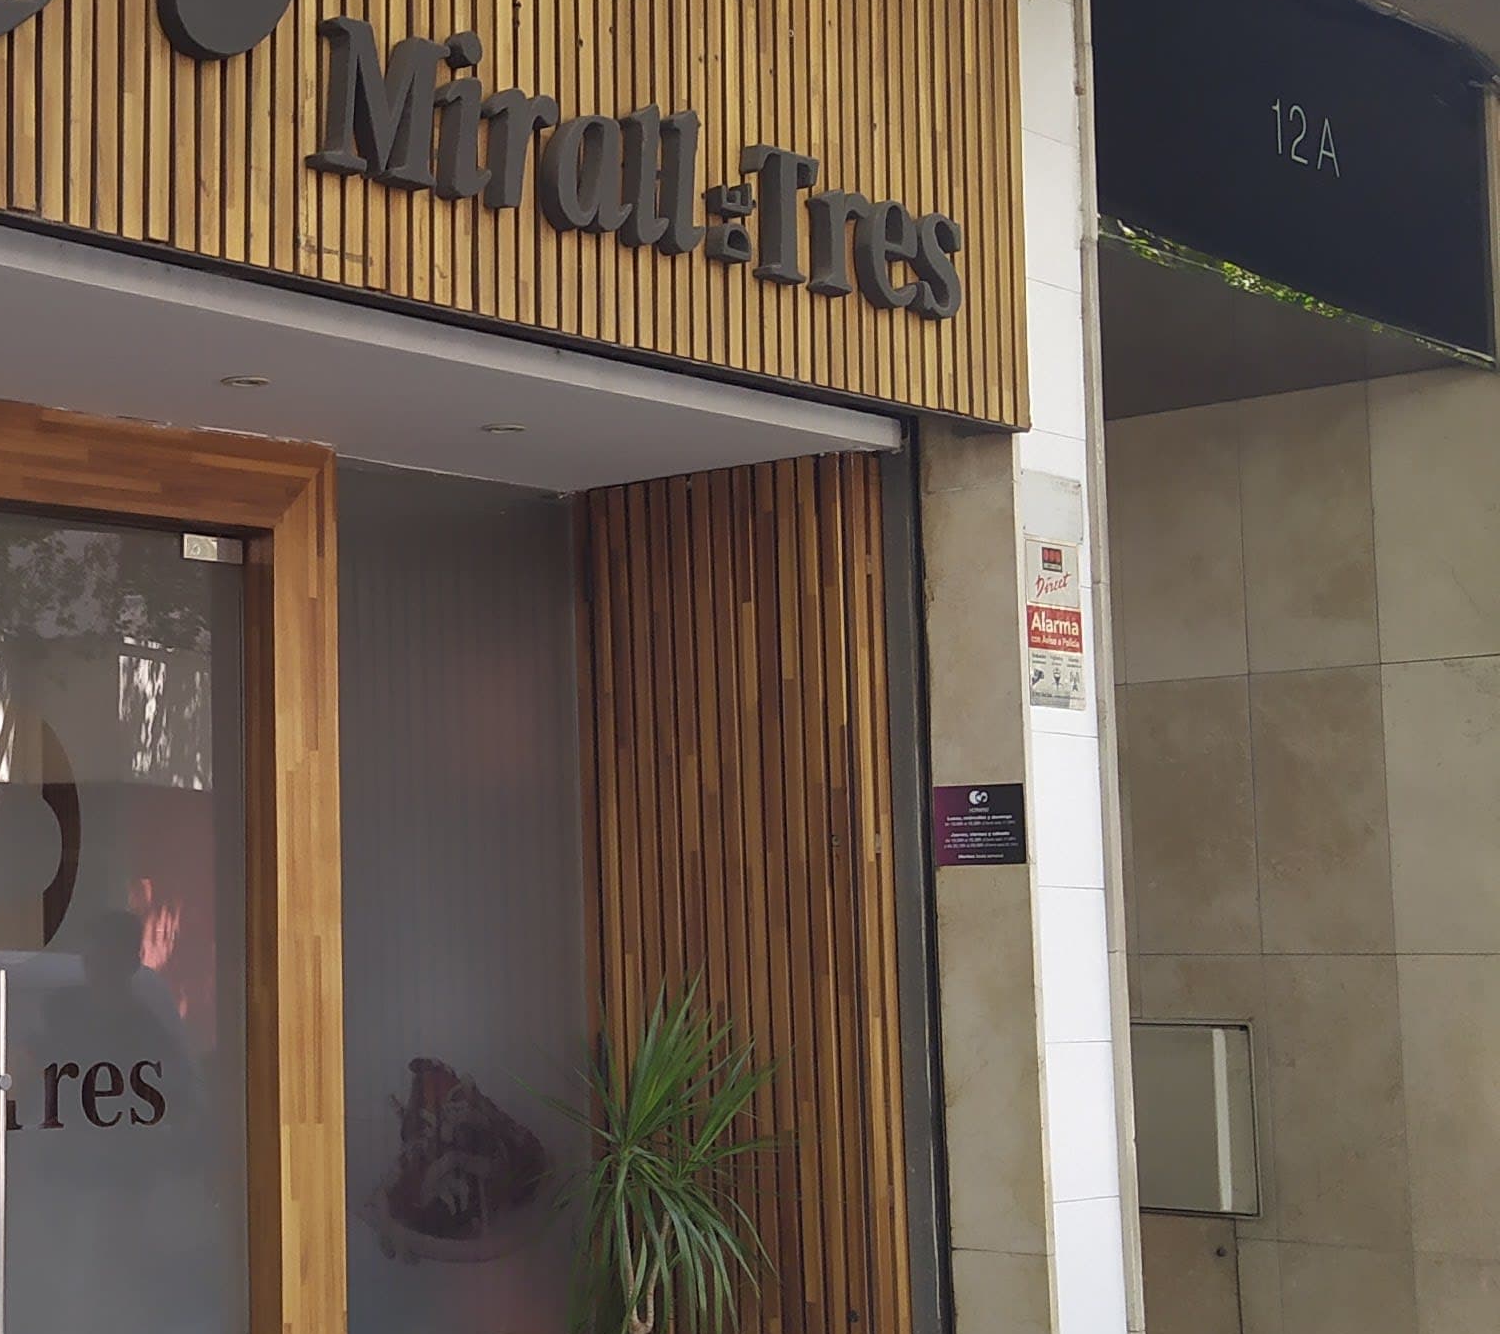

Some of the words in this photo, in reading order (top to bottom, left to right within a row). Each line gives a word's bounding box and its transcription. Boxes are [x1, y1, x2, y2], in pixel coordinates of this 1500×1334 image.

[1272, 98, 1340, 178] 12A
[306, 14, 706, 257] Mirall
[739, 144, 962, 321] Tres
[1035, 571, 1072, 599] Direct
[1031, 611, 1080, 637] Alarma
